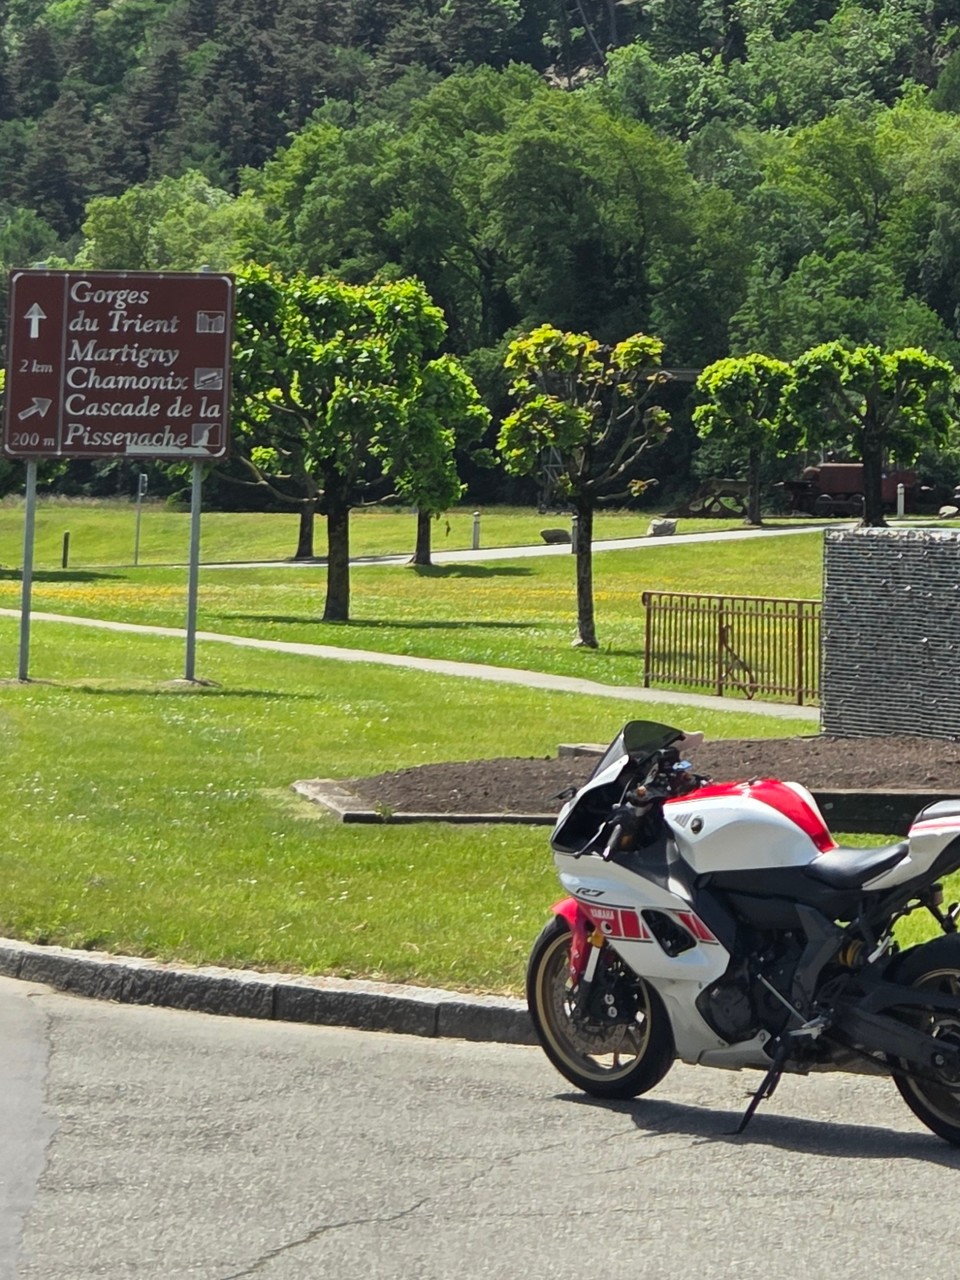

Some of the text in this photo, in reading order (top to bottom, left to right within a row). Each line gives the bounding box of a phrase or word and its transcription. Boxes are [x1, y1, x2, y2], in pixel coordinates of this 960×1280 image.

[70, 281, 150, 309] Gorges
[69, 310, 180, 333] du Trient
[68, 339, 179, 368] Martigny
[19, 360, 53, 373] 2 km
[66, 366, 189, 390] Chamonix
[65, 393, 221, 418] Cascade de la
[11, 432, 55, 447] 200 m
[64, 423, 188, 447] Pissevache
[576, 887, 605, 897] R7
[591, 908, 615, 920] YAMAHA
